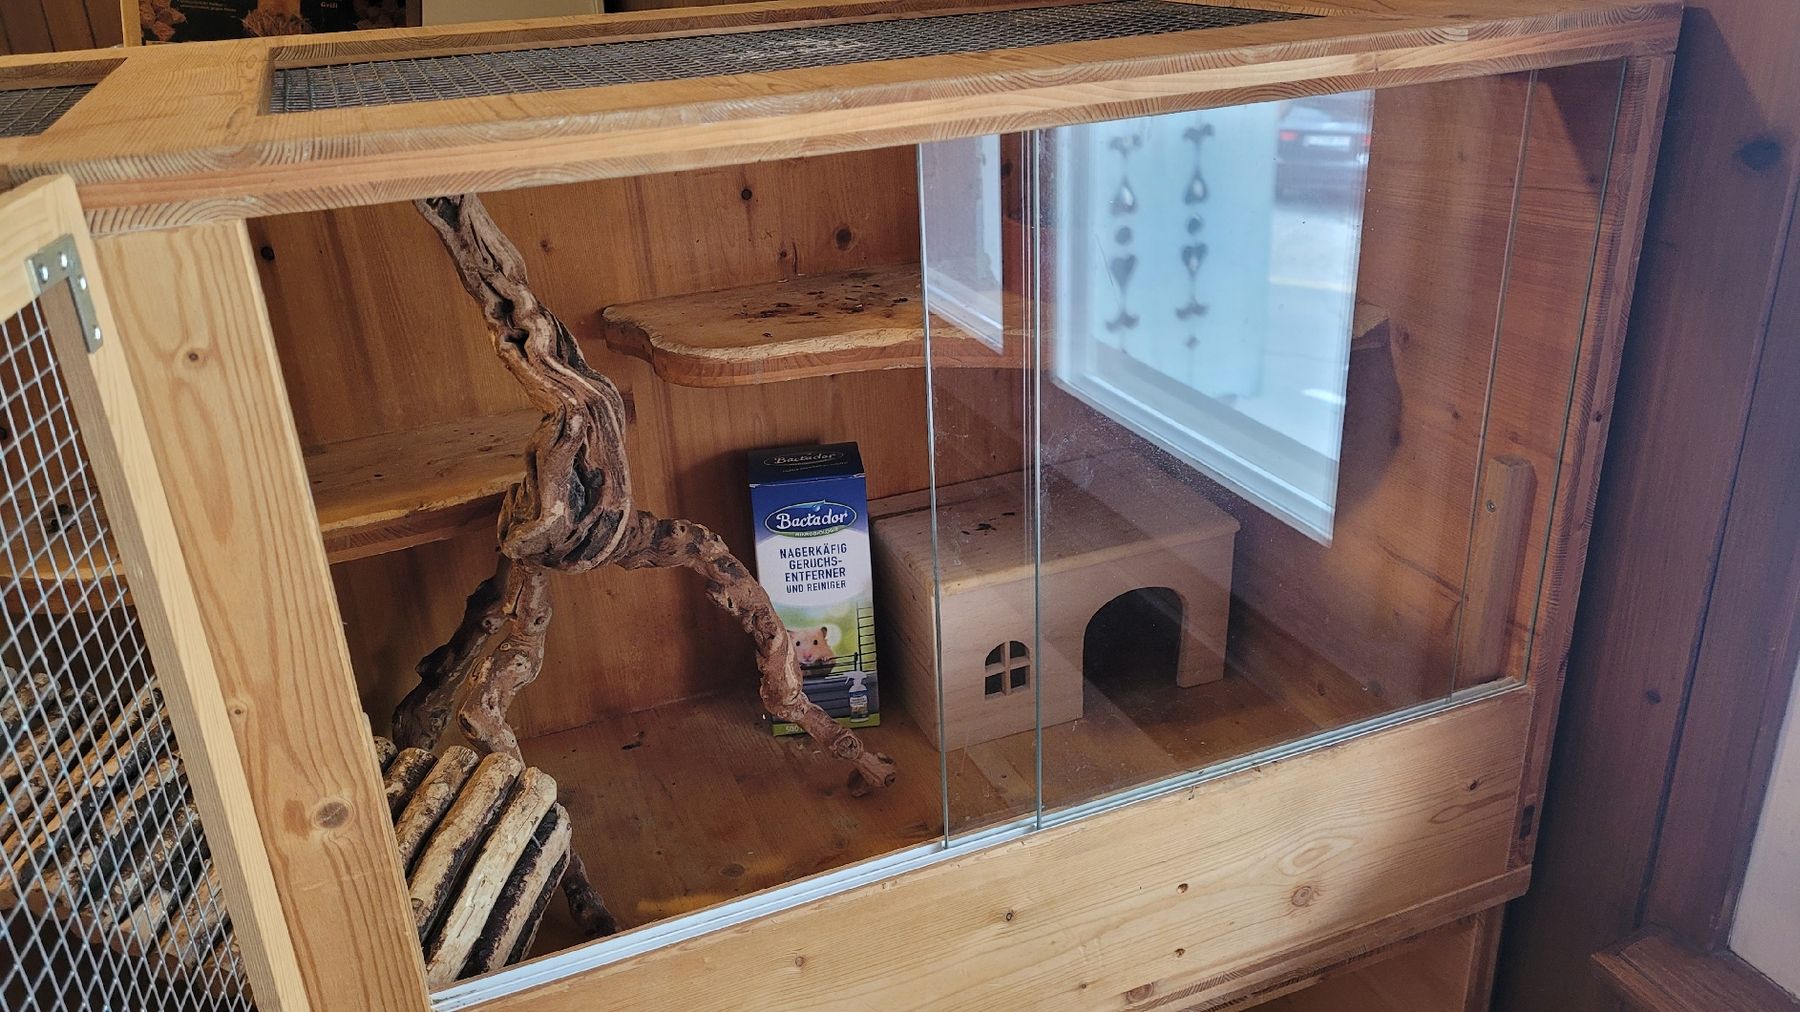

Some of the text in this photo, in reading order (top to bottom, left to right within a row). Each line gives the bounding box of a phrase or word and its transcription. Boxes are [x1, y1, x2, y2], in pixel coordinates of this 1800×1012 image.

[774, 452, 837, 464] Bactador
[776, 508, 848, 530] Bactador
[779, 542, 847, 559] NAGERKÄFIG
[789, 556, 843, 570] GERUCHS-
[785, 567, 846, 582] ENTFERNER
[786, 580, 847, 594] UND REINIGER
